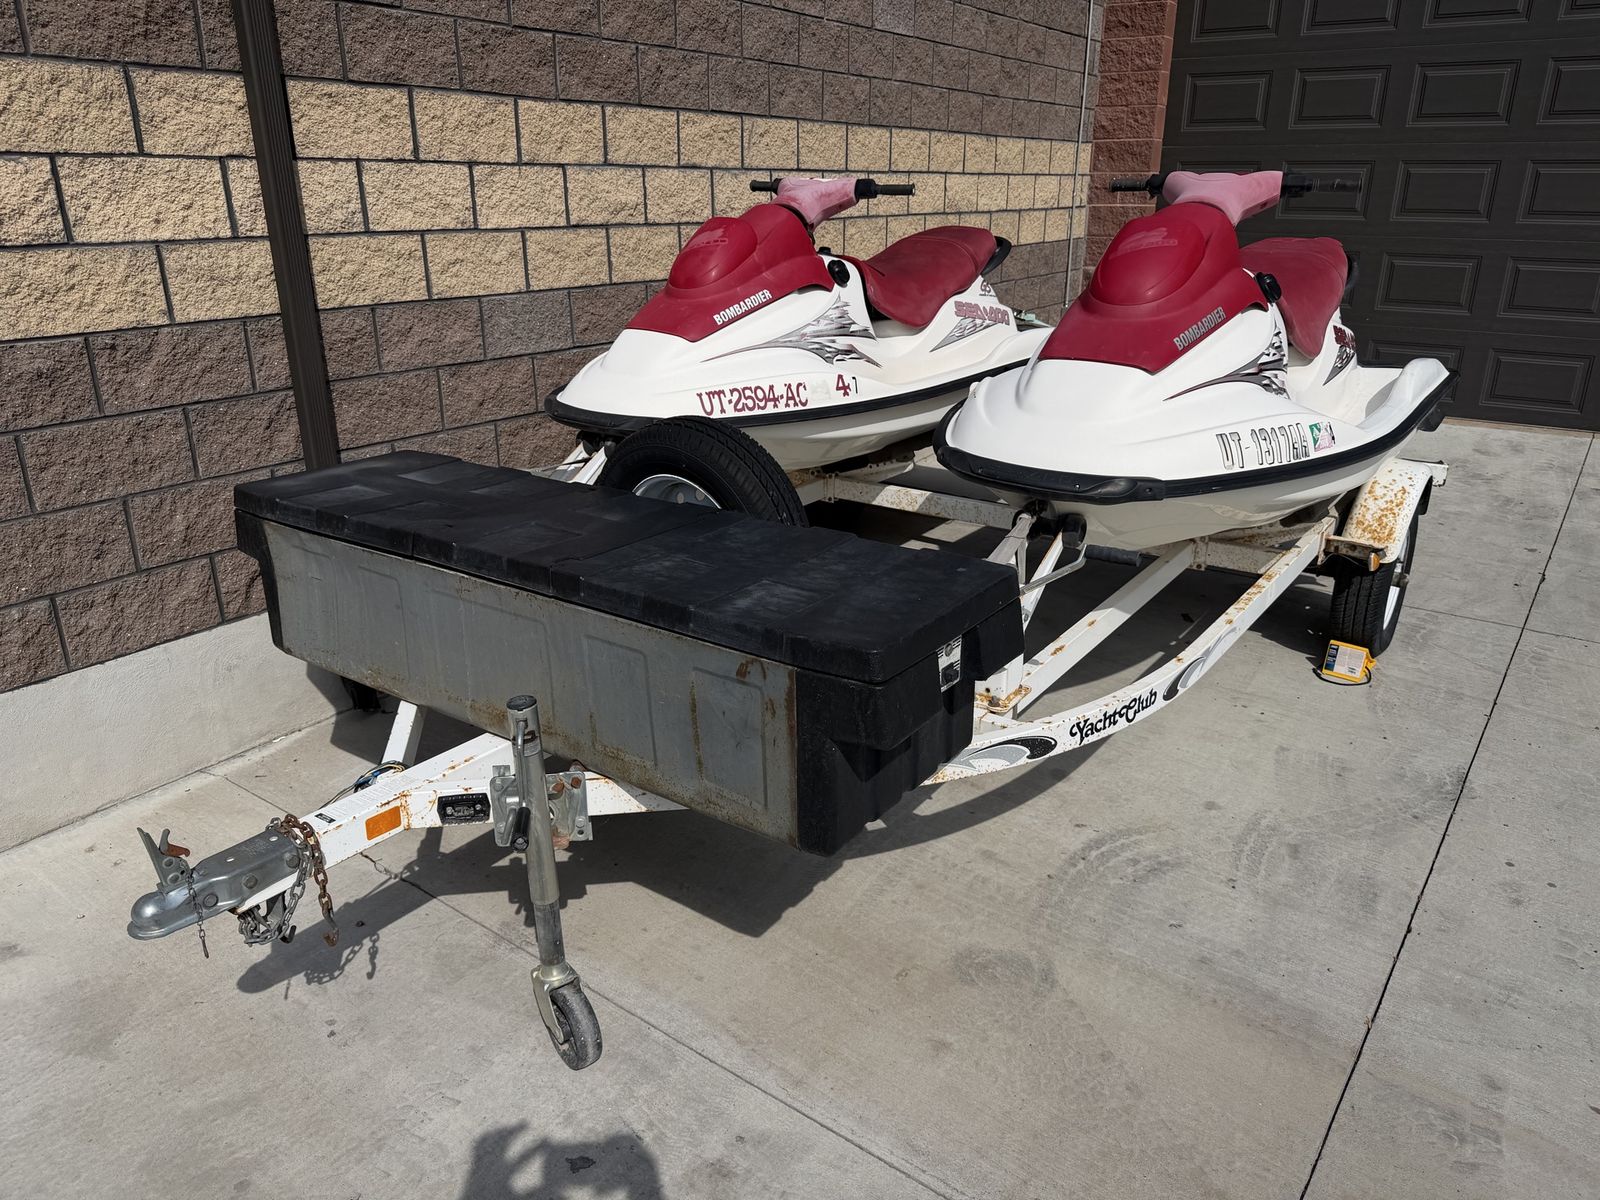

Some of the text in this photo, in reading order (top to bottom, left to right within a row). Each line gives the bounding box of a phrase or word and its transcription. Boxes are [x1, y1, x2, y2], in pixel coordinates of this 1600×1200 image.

[713, 289, 773, 326] BOMBARDIER
[1173, 306, 1227, 351] BOMBARDIER
[1069, 687, 1158, 746] Yacht Club
